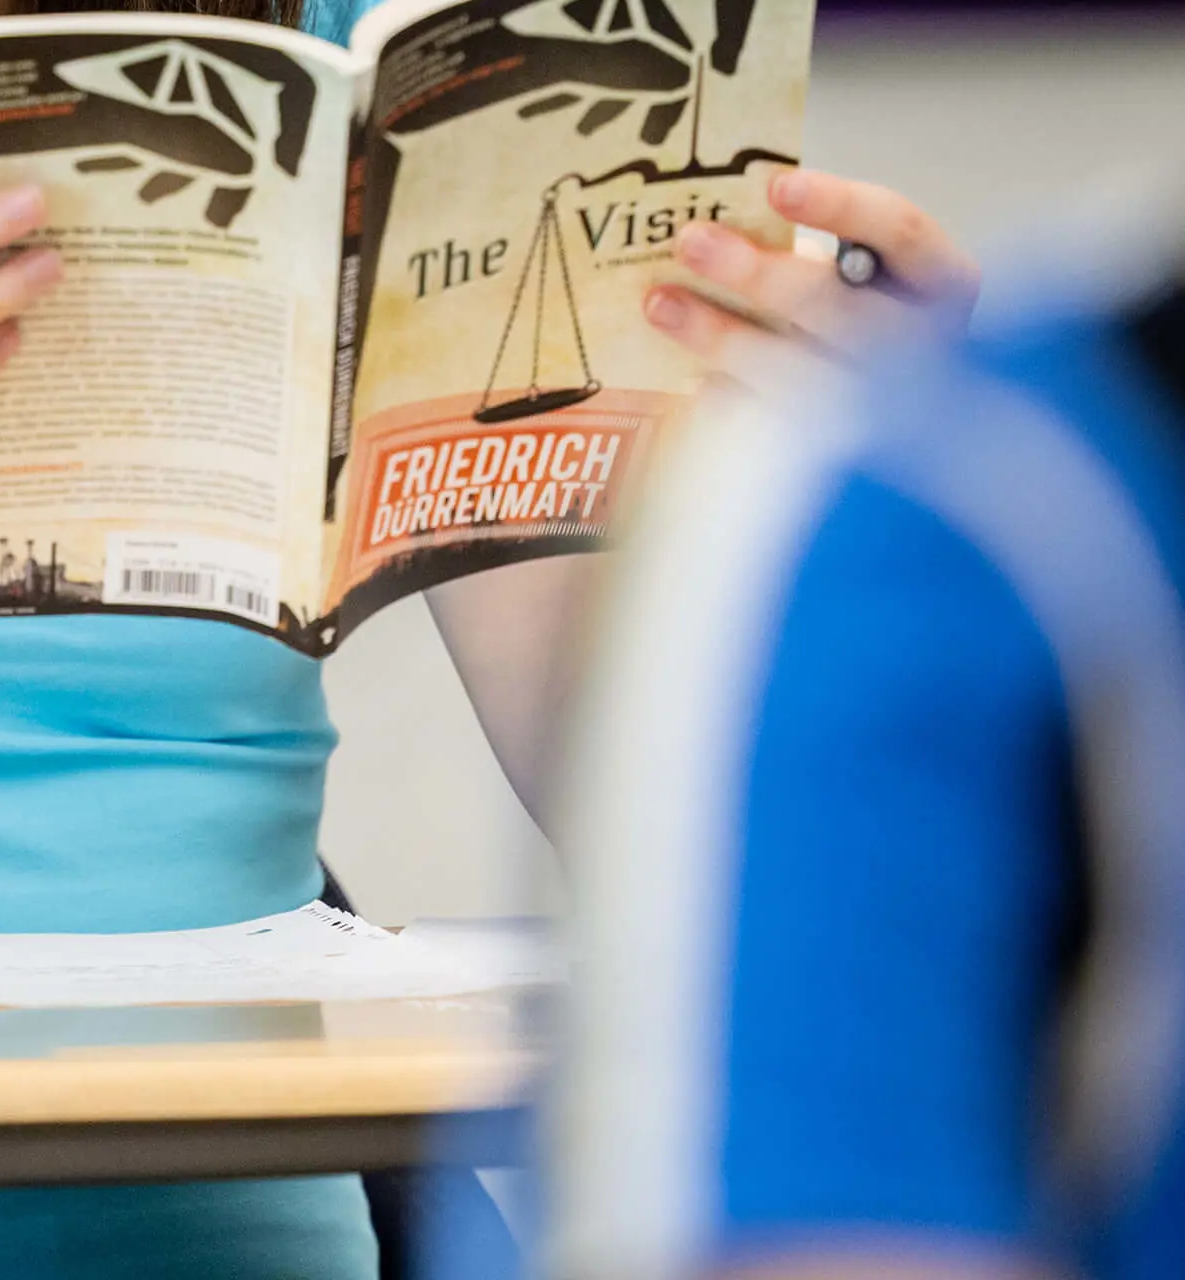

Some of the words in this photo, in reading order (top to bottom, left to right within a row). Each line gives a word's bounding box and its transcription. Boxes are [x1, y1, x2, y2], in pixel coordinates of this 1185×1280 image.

[408, 237, 508, 300] The
[379, 433, 621, 504] FRIEDRICH
[370, 482, 607, 545] DÜRRENMATT
